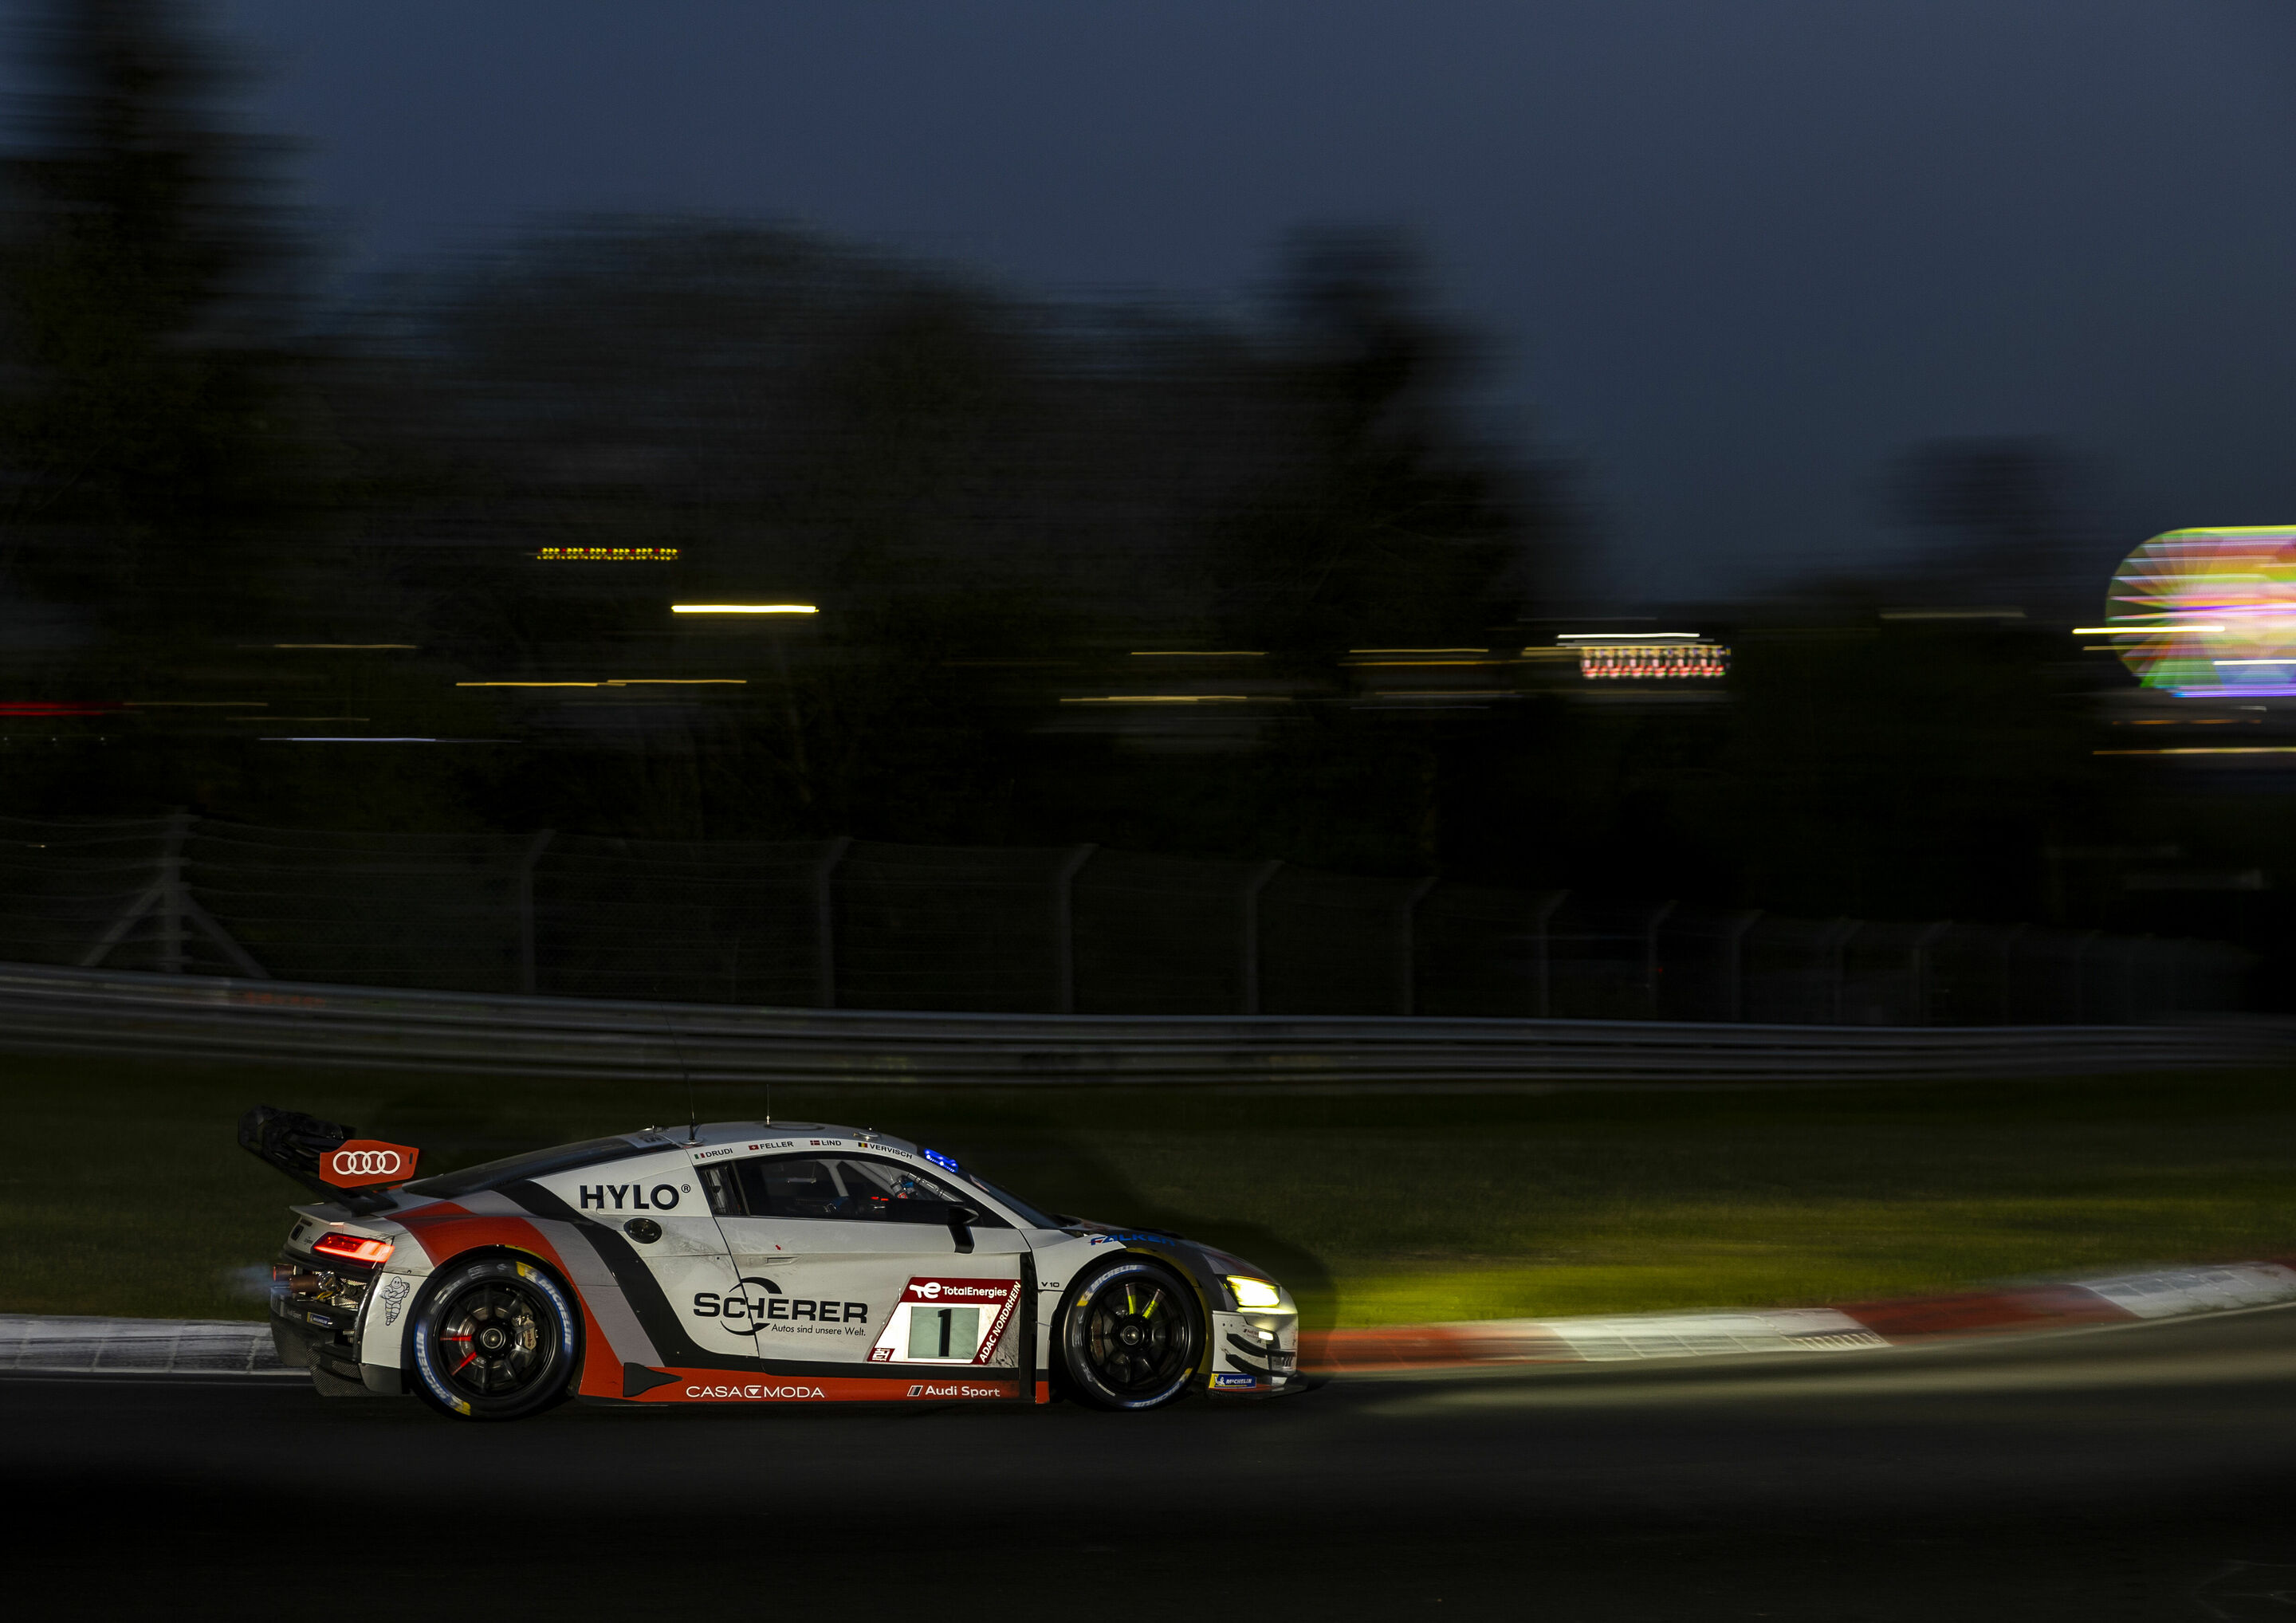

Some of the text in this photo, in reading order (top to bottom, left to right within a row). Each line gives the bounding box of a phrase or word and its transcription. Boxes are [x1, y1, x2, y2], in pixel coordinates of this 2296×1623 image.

[760, 1141, 794, 1150] FELLER
[869, 1143, 913, 1160] VERVISCH
[706, 1148, 733, 1158] DRUDI
[1089, 1234, 1176, 1247] FALKEN
[1091, 1264, 1138, 1291] MICHELIN
[942, 1286, 1008, 1299] TotalEnergies
[539, 1279, 573, 1346] MICHELIN
[694, 1292, 868, 1324] SCHERER
[979, 1281, 1021, 1363] ADAC NORDRHEIN
[771, 1324, 795, 1333] Autos
[796, 1325, 813, 1334] sind
[844, 1326, 867, 1337] Welt.
[938, 1308, 952, 1358] 1
[686, 1385, 825, 1398] CASA MODA
[925, 1385, 1001, 1398] Audi Sport
